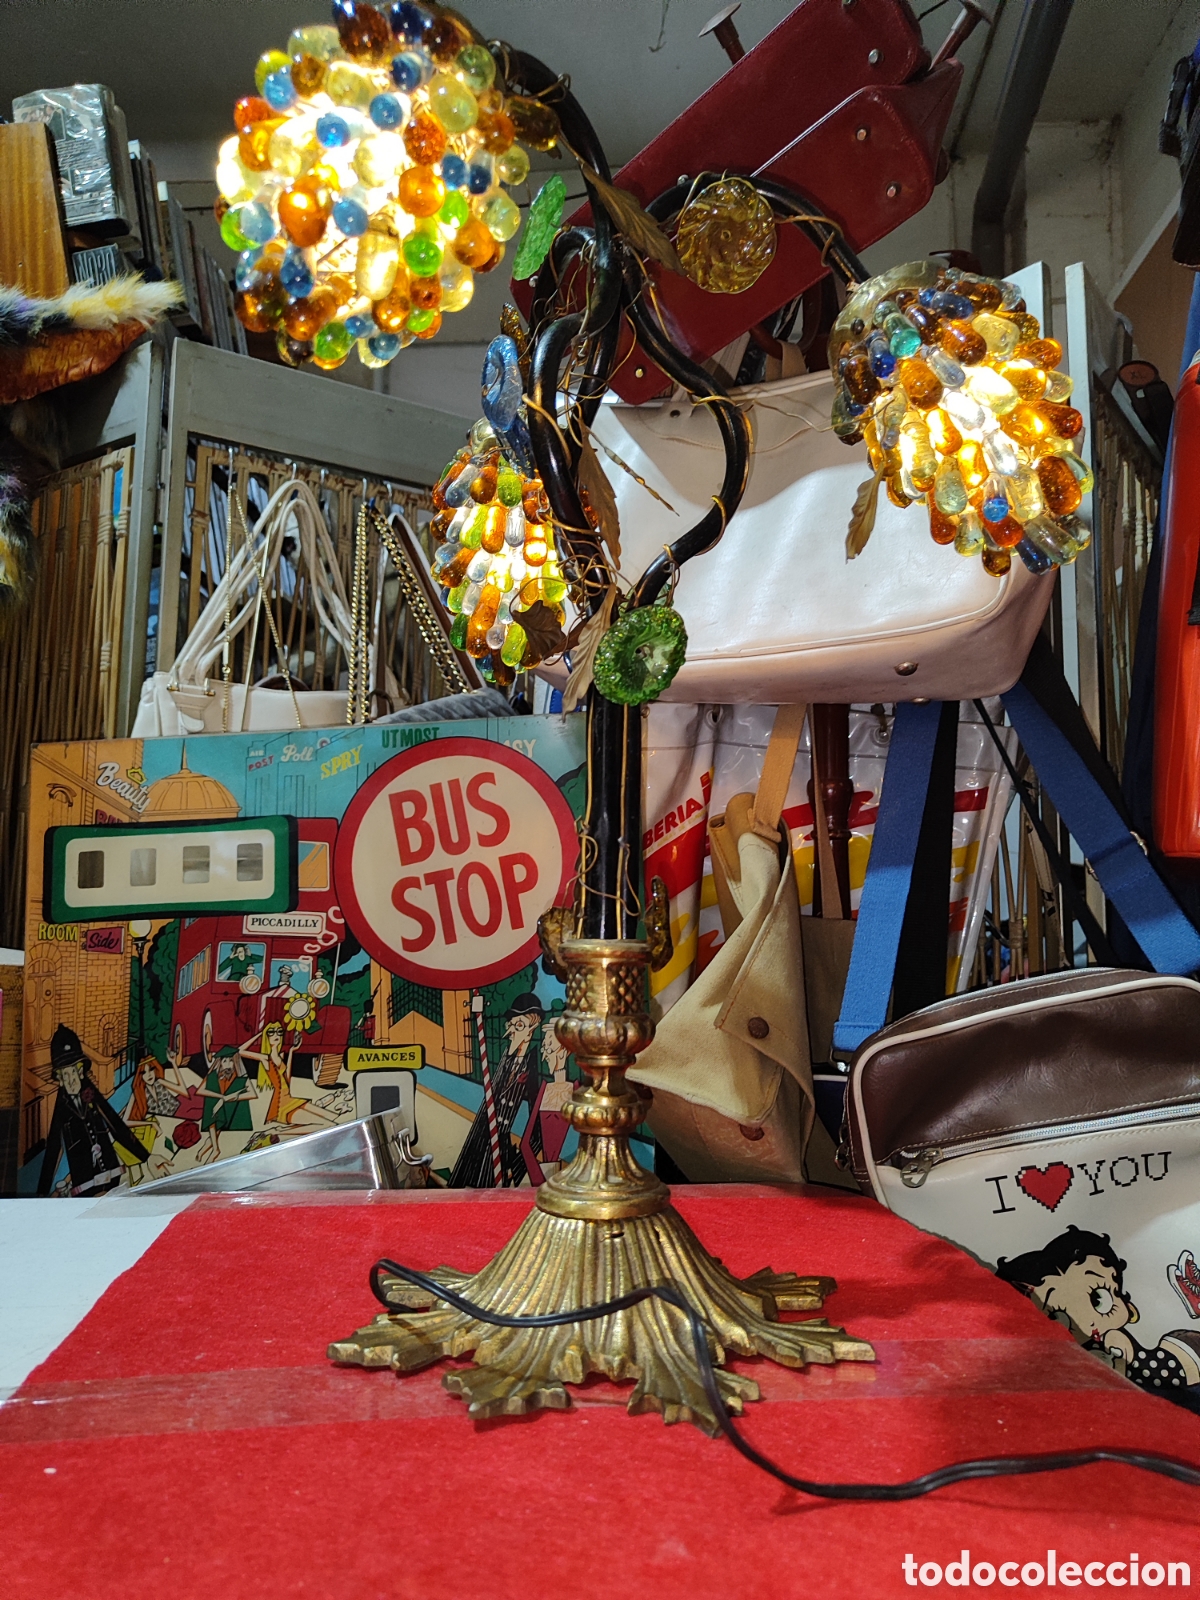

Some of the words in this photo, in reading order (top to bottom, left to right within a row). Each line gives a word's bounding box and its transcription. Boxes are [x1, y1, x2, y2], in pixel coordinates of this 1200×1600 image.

[382, 727, 440, 749] UTMOST
[248, 755, 274, 773] POST
[321, 743, 363, 780] SPRY
[96, 762, 152, 814] Beauty
[388, 771, 511, 866] BUS
[642, 797, 704, 851] BERIA
[391, 852, 539, 952] STOP
[38, 923, 78, 942] ROOM
[251, 917, 319, 928] PICCADILLY
[88, 931, 119, 949] Side
[357, 1051, 416, 1063] AVANCES
[985, 1175, 1016, 1214] I
[1077, 1151, 1172, 1196] YOU
